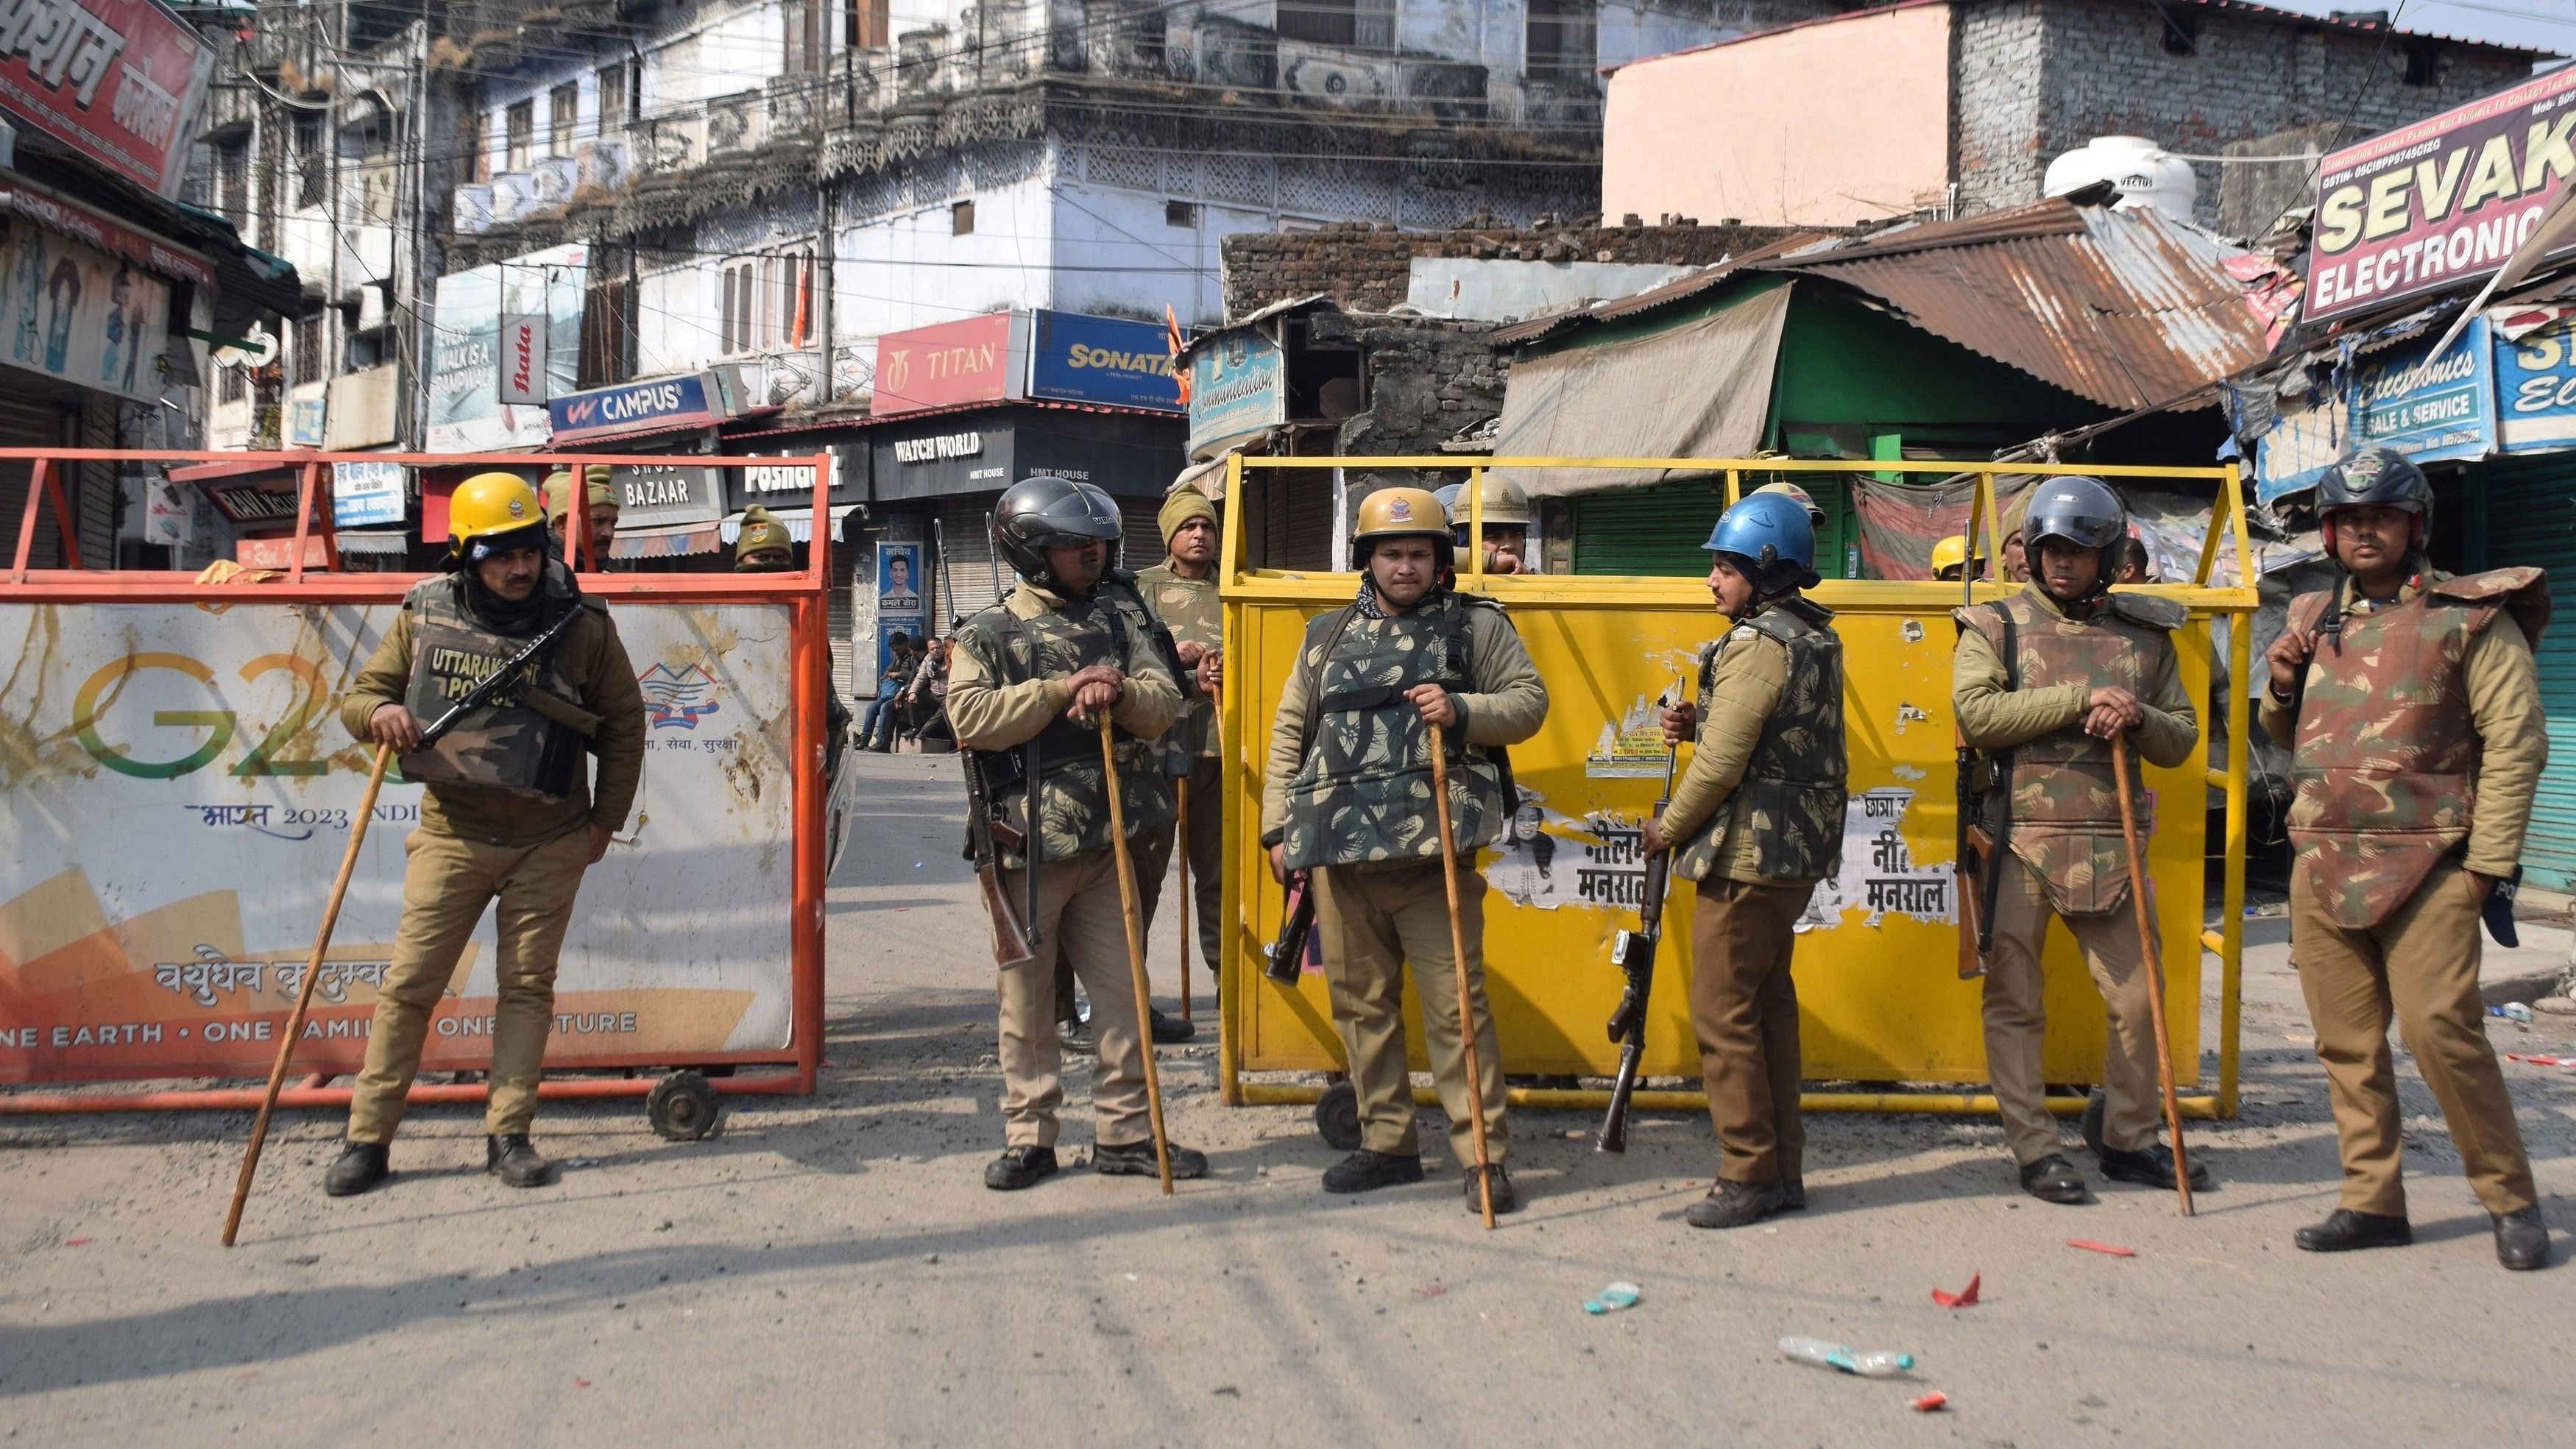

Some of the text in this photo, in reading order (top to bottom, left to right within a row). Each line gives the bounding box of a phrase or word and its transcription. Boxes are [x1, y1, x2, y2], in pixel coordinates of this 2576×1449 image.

[2120, 176, 2154, 188] VECTUS
[2318, 110, 2576, 255] SEVAK
[513, 323, 532, 396] Bata
[927, 341, 996, 380] TITAN
[601, 384, 679, 420] CAMPUS
[2367, 394, 2470, 436] SALE & SERVICE
[895, 432, 980, 463] WATCH WORLD
[745, 444, 844, 493] Poshak
[970, 467, 1004, 481] HMT HOUSE
[1030, 467, 1089, 480] HMT HOUSE
[626, 479, 690, 506] BAZAAR
[885, 545, 911, 556] सचिव
[881, 598, 901, 607] कमल
[702, 739, 738, 754] सुरक्षा
[283, 809, 348, 829] 2023
[369, 804, 418, 821] NDI
[1864, 797, 1894, 818] छात्रा
[1865, 879, 1947, 913] मनराल
[52, 1022, 163, 1048] EARTH
[203, 1019, 272, 1043] ONE
[548, 1012, 637, 1035] TURE
